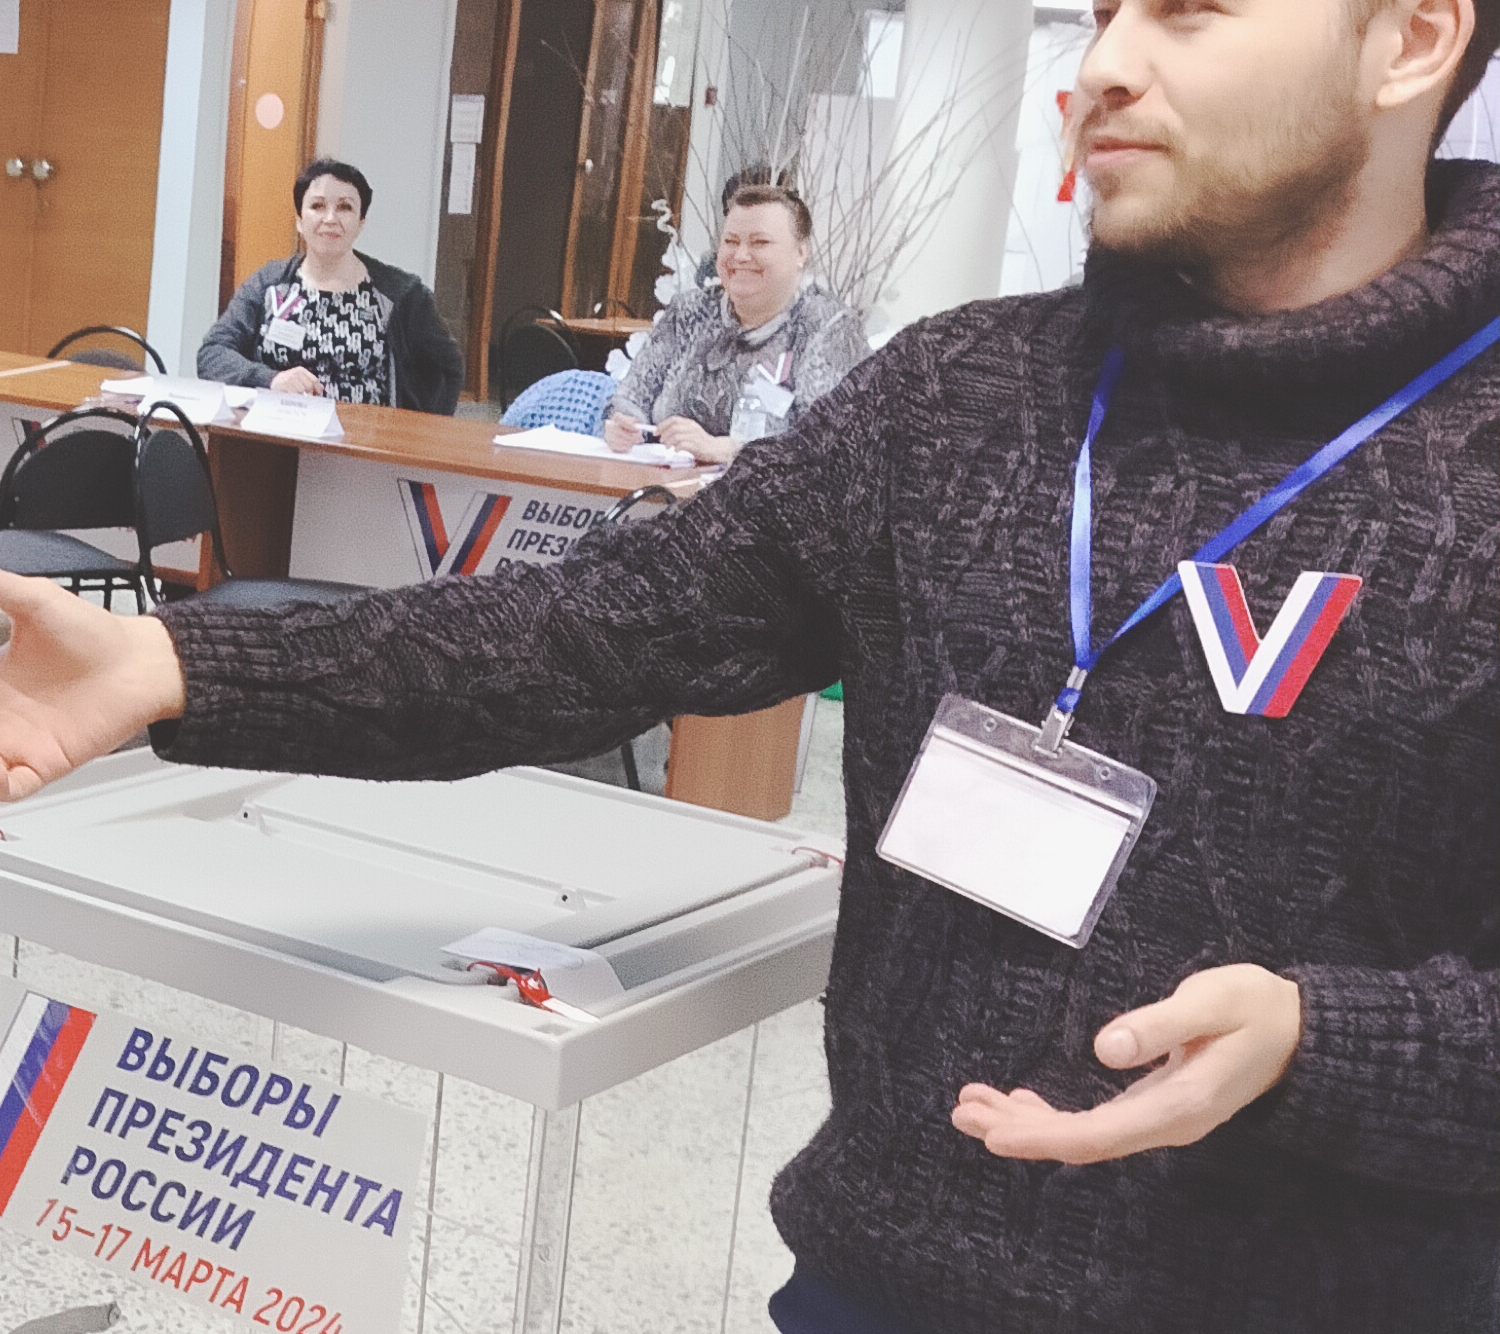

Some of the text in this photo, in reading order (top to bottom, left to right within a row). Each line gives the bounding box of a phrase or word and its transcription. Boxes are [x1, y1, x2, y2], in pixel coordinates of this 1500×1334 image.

[116, 1027, 341, 1137] ВЫБОРЫ
[60, 1146, 257, 1251] РОССИИ
[88, 1087, 404, 1237] ПРЕЗИДЕНТА
[130, 1236, 250, 1314] МАРТА
